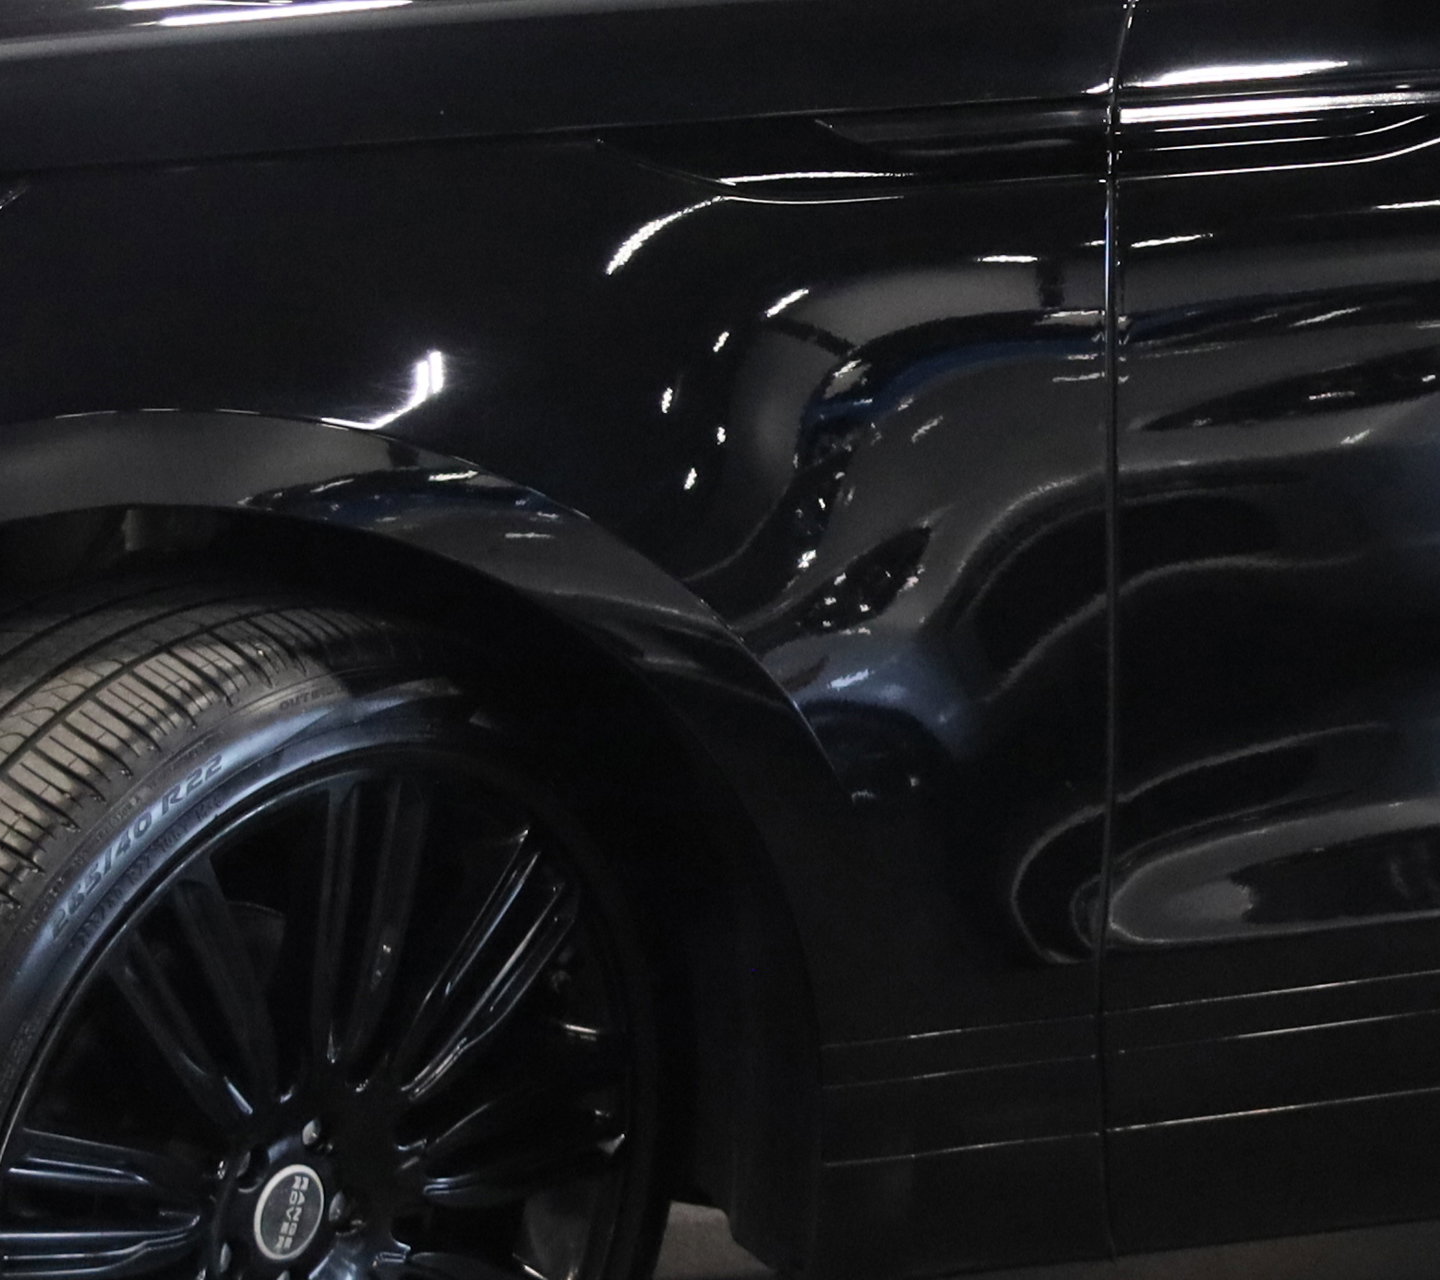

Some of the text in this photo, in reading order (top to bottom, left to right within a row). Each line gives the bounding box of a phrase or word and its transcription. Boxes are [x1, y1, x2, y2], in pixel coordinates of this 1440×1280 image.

[53, 812, 152, 939] 265/40
[162, 755, 222, 815] R22
[274, 1175, 302, 1249] ROVER
[282, 1176, 310, 1249] RANGE
